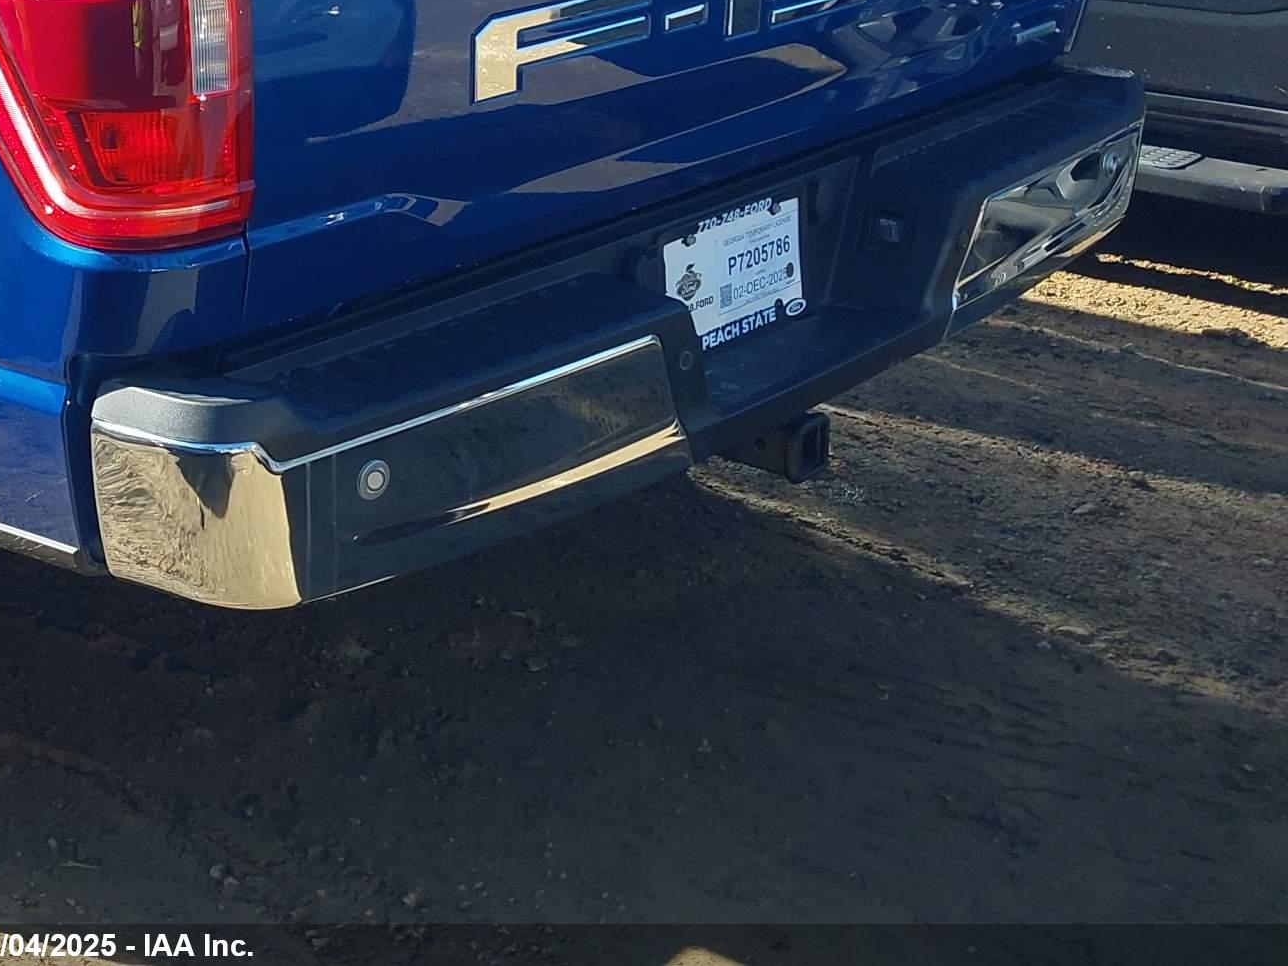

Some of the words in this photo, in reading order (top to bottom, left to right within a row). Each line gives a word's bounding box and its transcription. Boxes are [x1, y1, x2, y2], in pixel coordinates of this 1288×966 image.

[697, 197, 772, 233] 770-748-FORD
[728, 234, 790, 276] P7205786
[701, 321, 741, 352] PEACH
[741, 306, 778, 334] STATE
